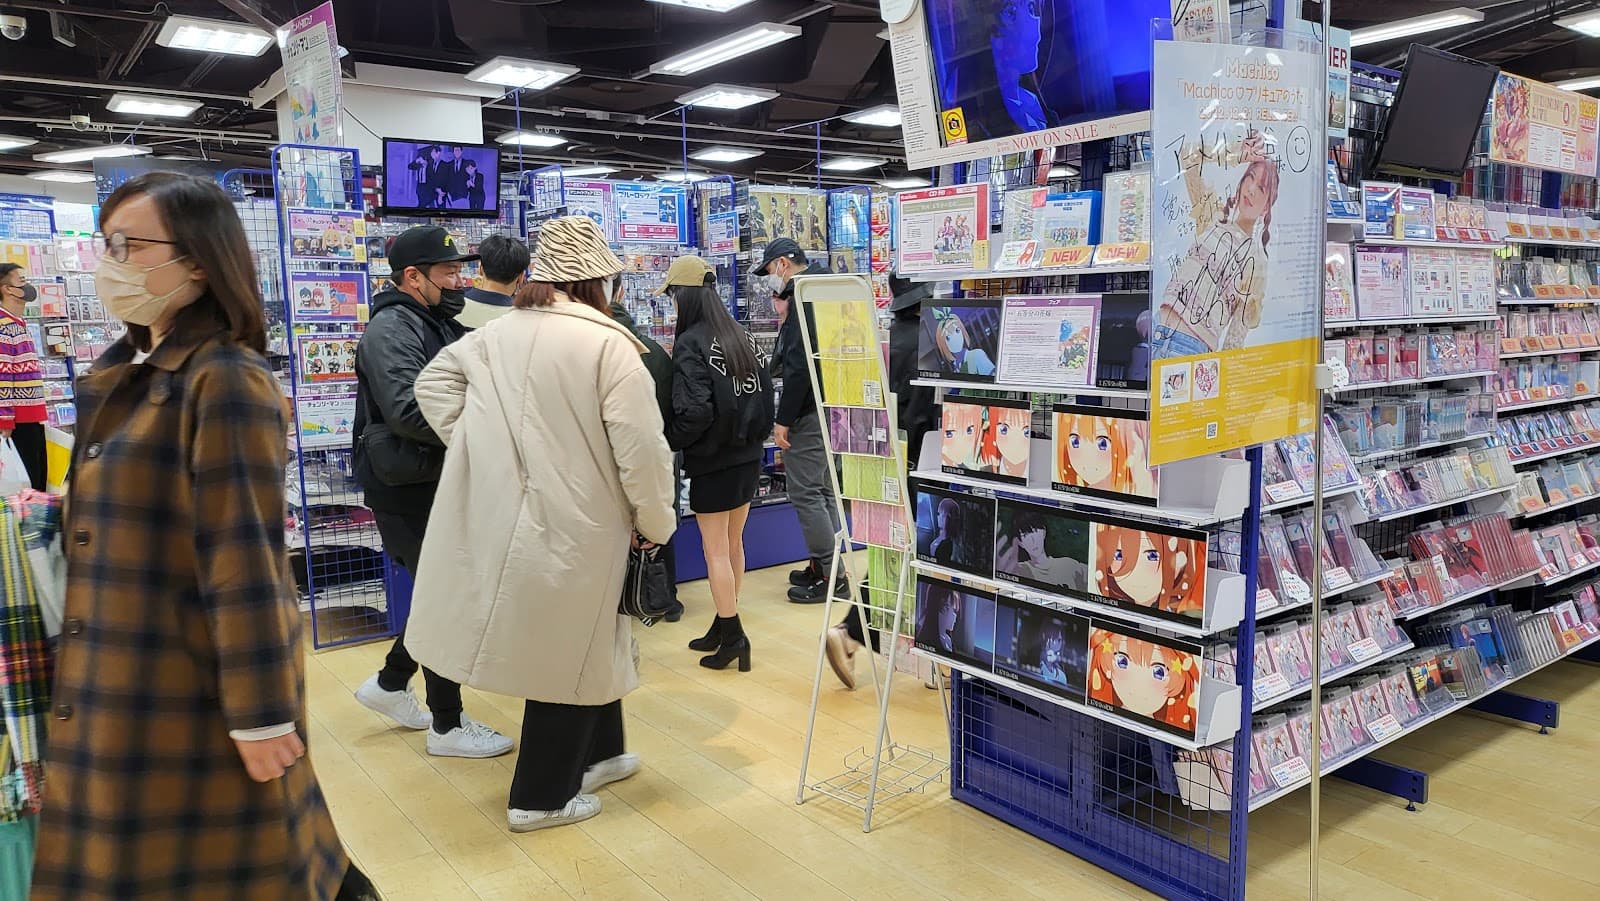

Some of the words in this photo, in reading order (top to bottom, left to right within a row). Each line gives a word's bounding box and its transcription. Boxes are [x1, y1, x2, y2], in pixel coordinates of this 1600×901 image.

[1226, 57, 1280, 81] Machico
[1012, 135, 1040, 150] NOW
[1043, 130, 1061, 146] ON
[1064, 124, 1099, 142] SALE
[1051, 250, 1081, 263] NEW
